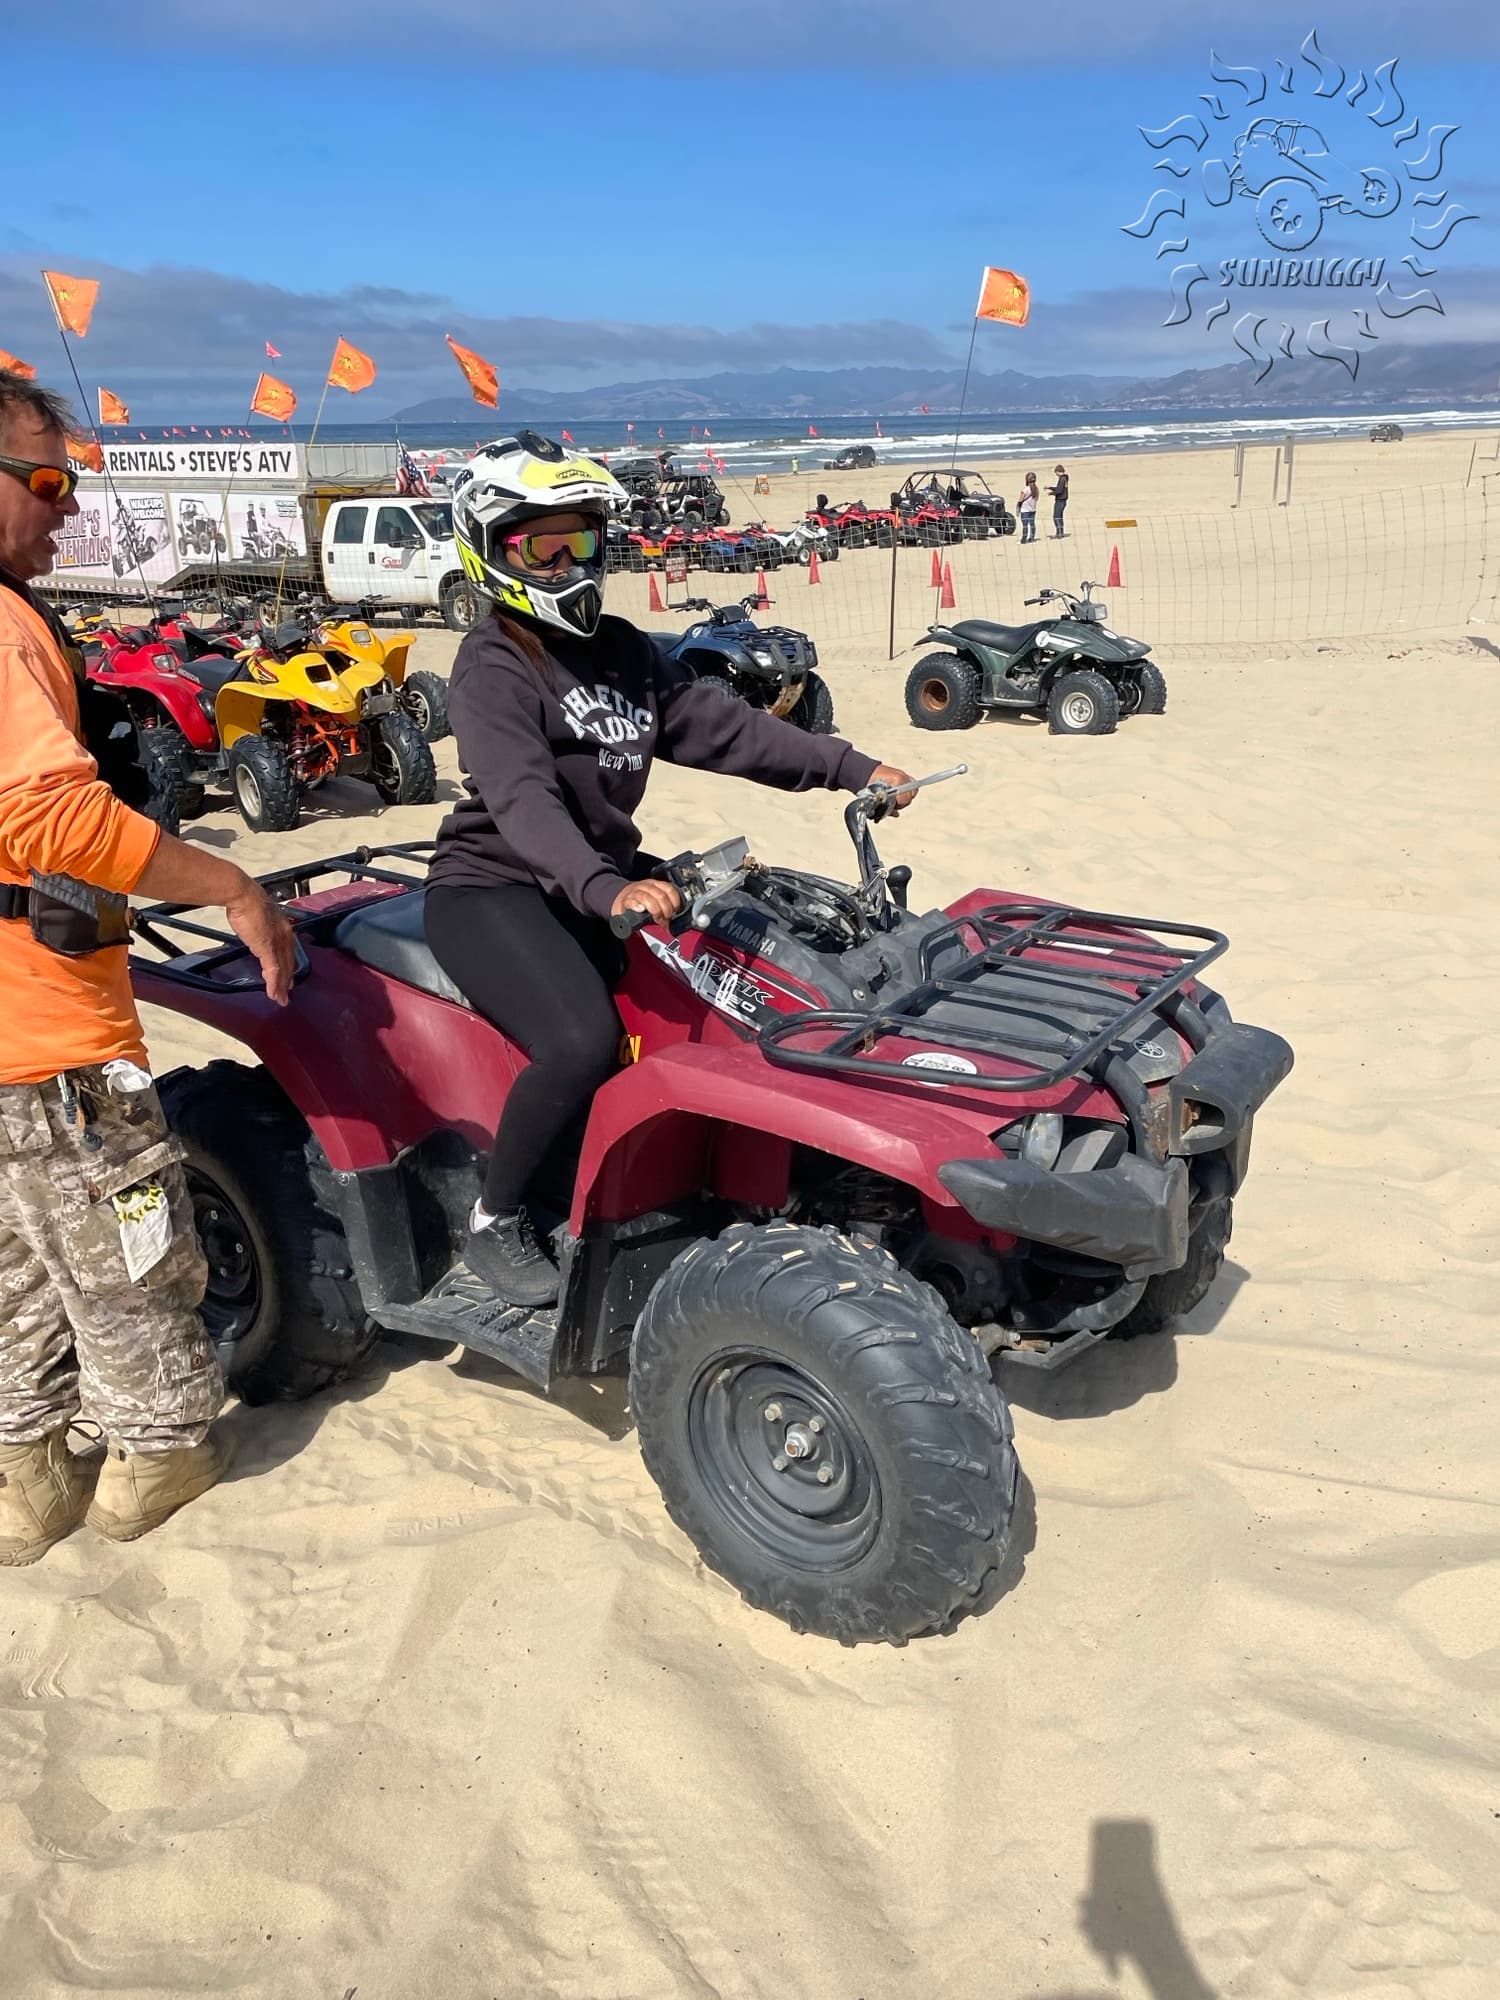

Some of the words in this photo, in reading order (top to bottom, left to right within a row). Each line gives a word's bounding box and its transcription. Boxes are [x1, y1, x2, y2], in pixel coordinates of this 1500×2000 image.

[110, 451, 175, 472] RENTALS
[189, 450, 251, 473] STEVE'S
[258, 451, 292, 473] ATV
[56, 535, 112, 568] RENTALS
[560, 684, 653, 740] ATHLETIC
[585, 716, 639, 744] CLUB
[726, 920, 778, 957] YAMAHA
